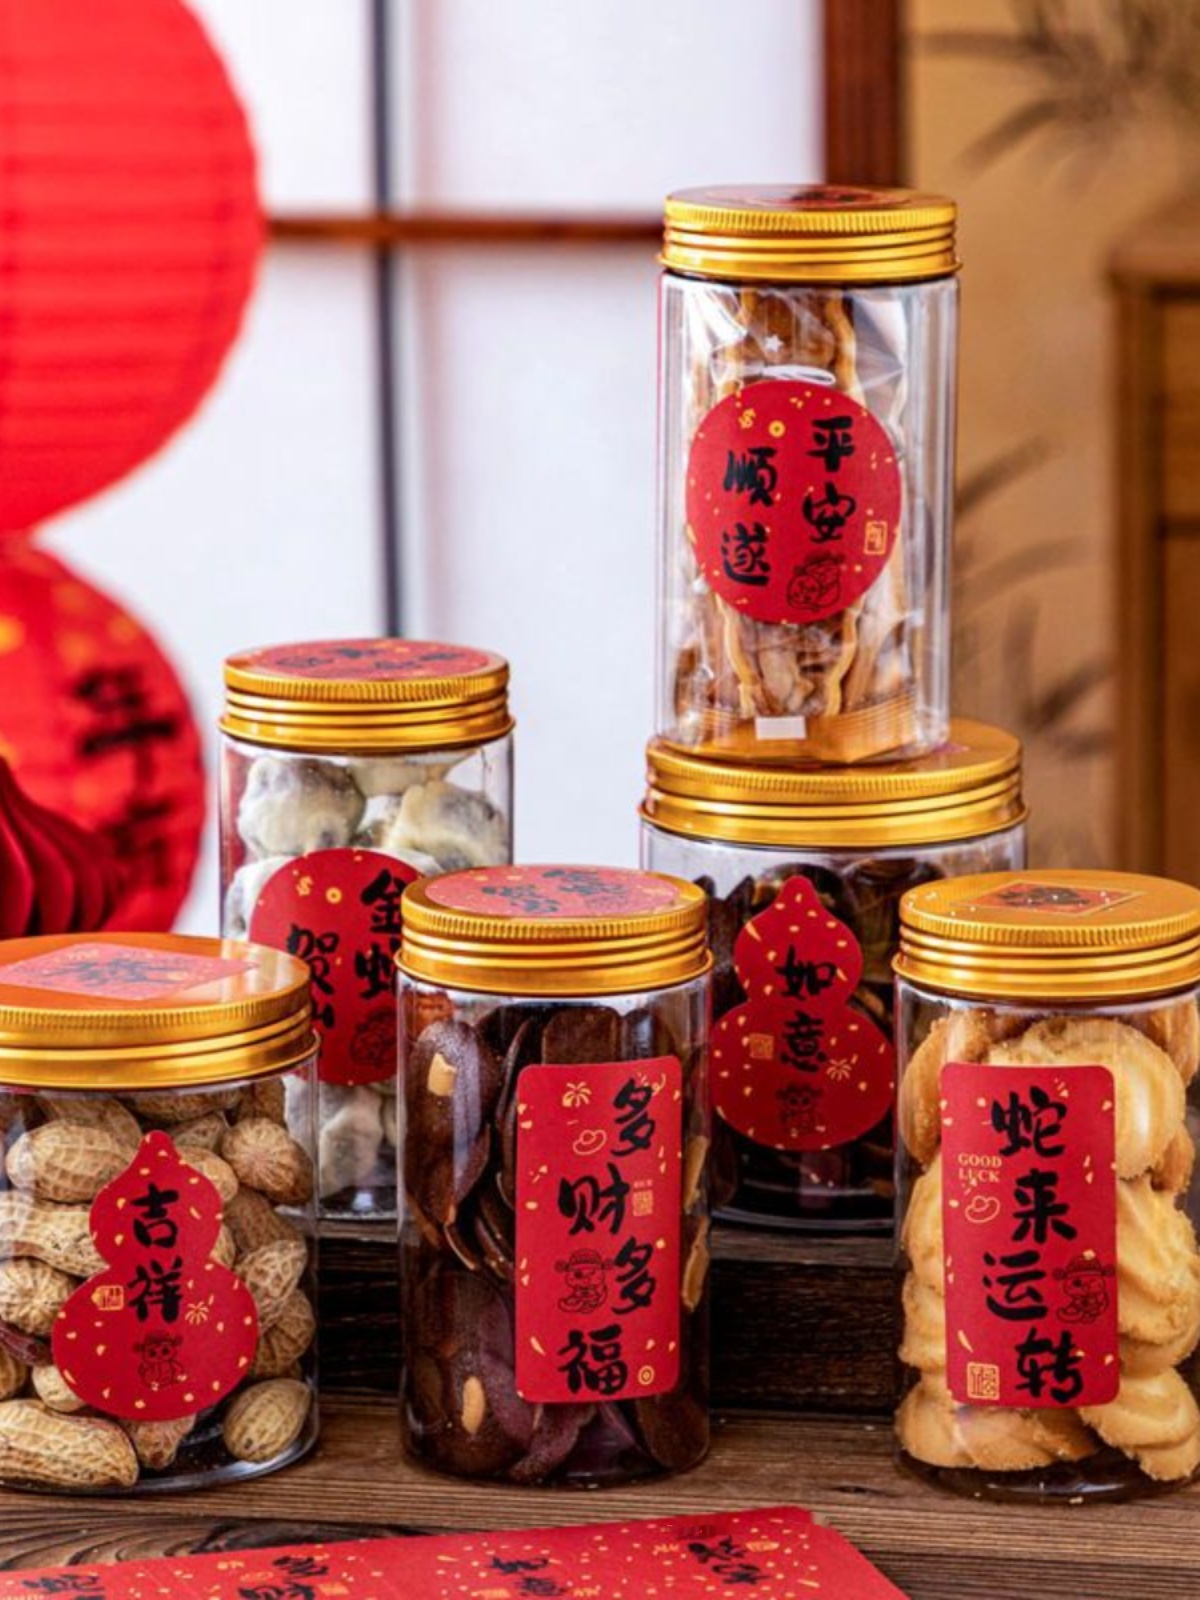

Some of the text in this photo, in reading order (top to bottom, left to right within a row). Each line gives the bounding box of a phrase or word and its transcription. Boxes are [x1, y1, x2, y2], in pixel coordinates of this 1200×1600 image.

[721, 446, 778, 587] 顺遂
[802, 415, 857, 544] 平安
[775, 944, 837, 1073] 如意
[957, 1152, 1003, 1170] GOOD
[957, 1167, 1001, 1184] LUCK
[126, 1183, 184, 1324] 吉祥
[557, 1077, 657, 1395] 多财多福
[982, 1085, 1084, 1404] 蛇来运转
